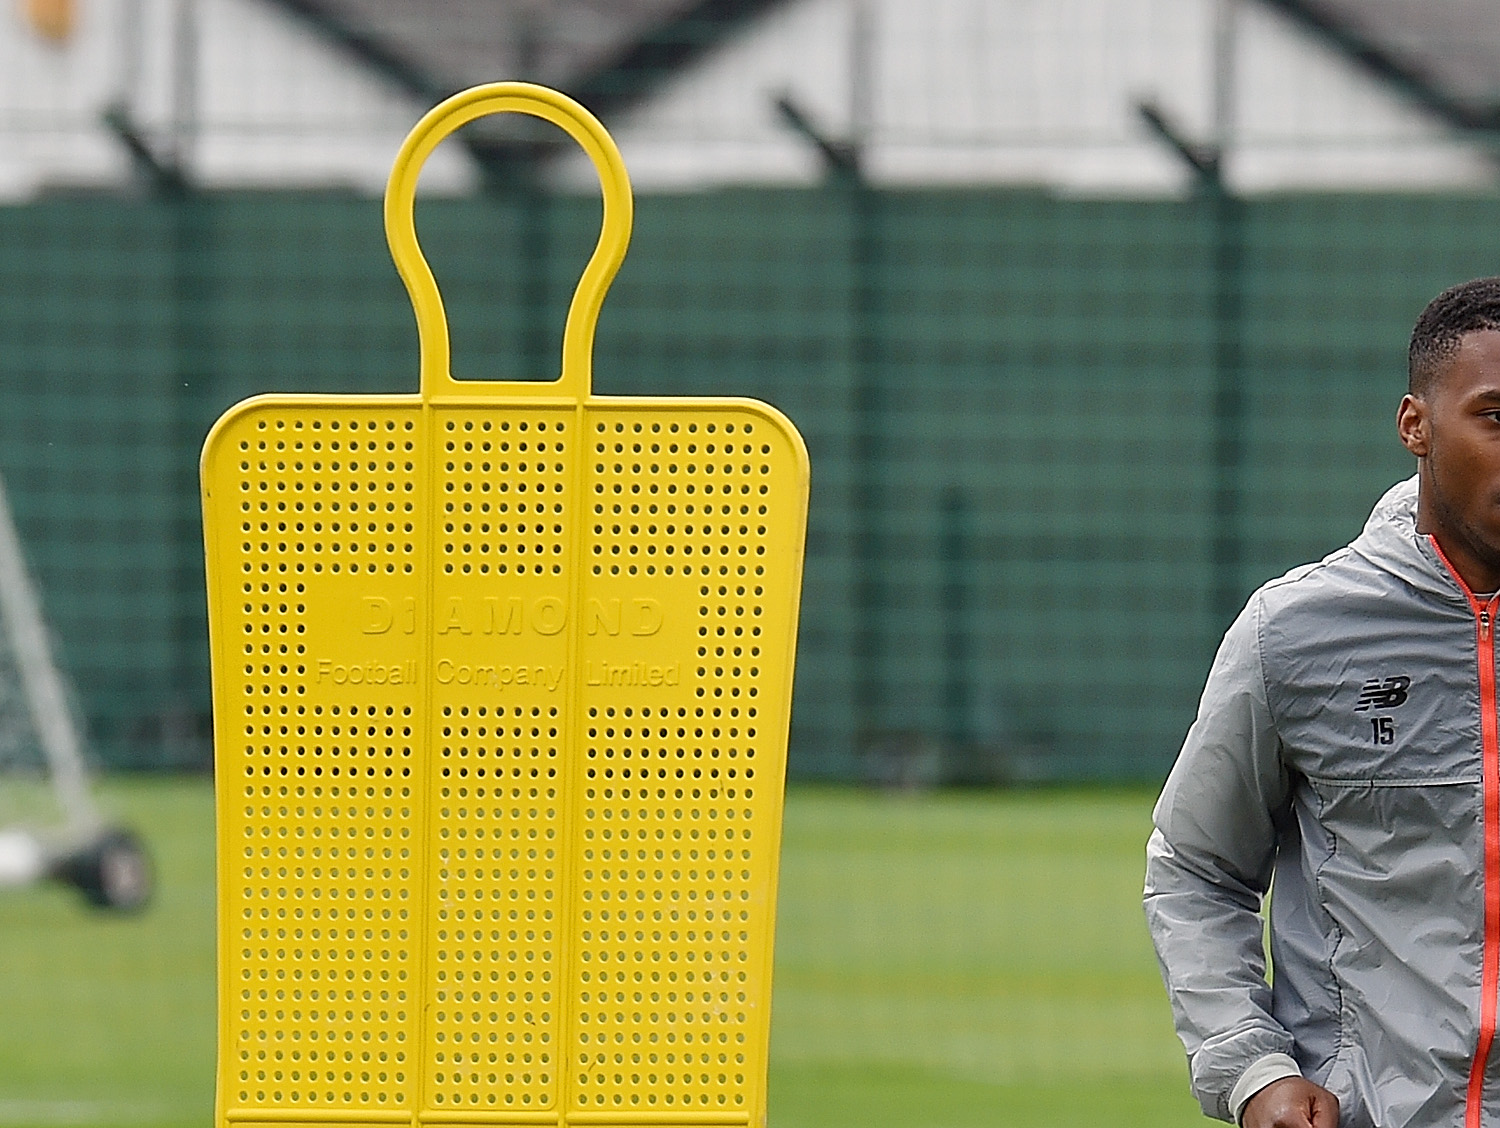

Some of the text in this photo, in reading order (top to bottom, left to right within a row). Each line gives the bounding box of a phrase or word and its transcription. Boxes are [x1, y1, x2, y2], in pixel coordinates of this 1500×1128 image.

[361, 595, 665, 638] DIAMOND
[316, 657, 680, 691] Football Company Limited
[1370, 717, 1395, 746] 15
